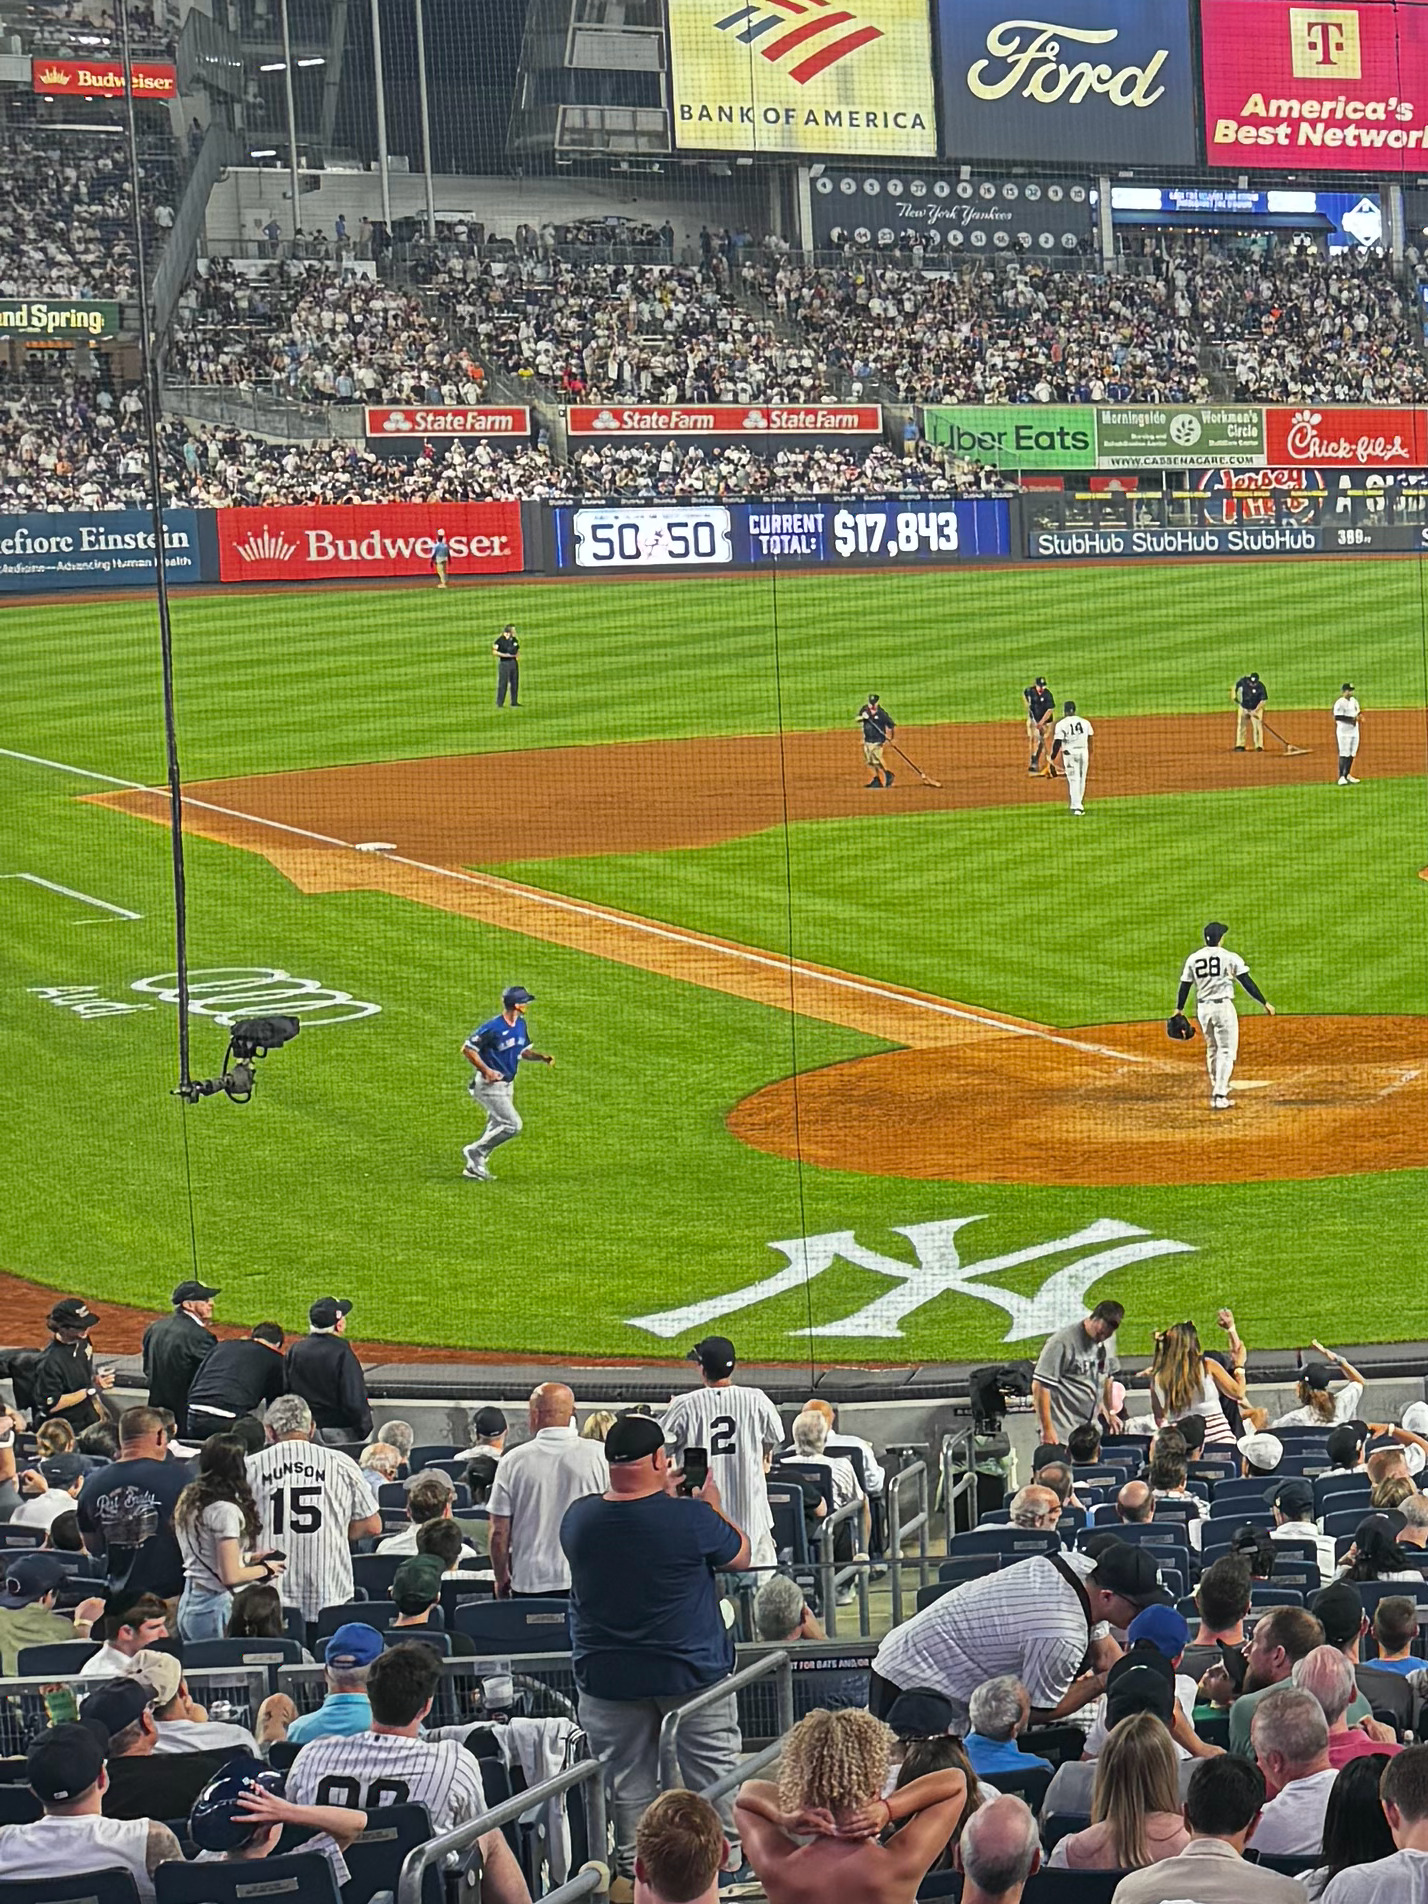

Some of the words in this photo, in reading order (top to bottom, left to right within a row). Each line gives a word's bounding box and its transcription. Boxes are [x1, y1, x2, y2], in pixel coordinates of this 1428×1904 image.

[967, 19, 1169, 109] Ford
[680, 104, 753, 123] BANK
[763, 107, 796, 125] OF
[804, 109, 926, 131] AMERICA
[1241, 93, 1414, 121] America's
[1213, 119, 1290, 146] Best
[896, 202, 925, 217] New
[925, 204, 958, 225] York
[961, 206, 1013, 226] Yankees
[1015, 425, 1089, 451] Eats
[1287, 421, 1410, 463] Chick-fil-A
[749, 513, 825, 534] CURRENT
[834, 509, 958, 558] $17,843
[305, 529, 506, 561] Budweser
[591, 524, 640, 561] 50
[667, 522, 716, 558] 50
[758, 536, 817, 555] TOTAL:
[1038, 533, 1124, 555] StubHub
[1132, 532, 1219, 553] StubHub
[1228, 530, 1315, 551] StubHub
[1070, 722, 1083, 735] 14
[1195, 956, 1220, 978] 28
[710, 1416, 736, 1456] 2
[261, 1461, 326, 1484] MUNSON
[269, 1487, 321, 1535] 15
